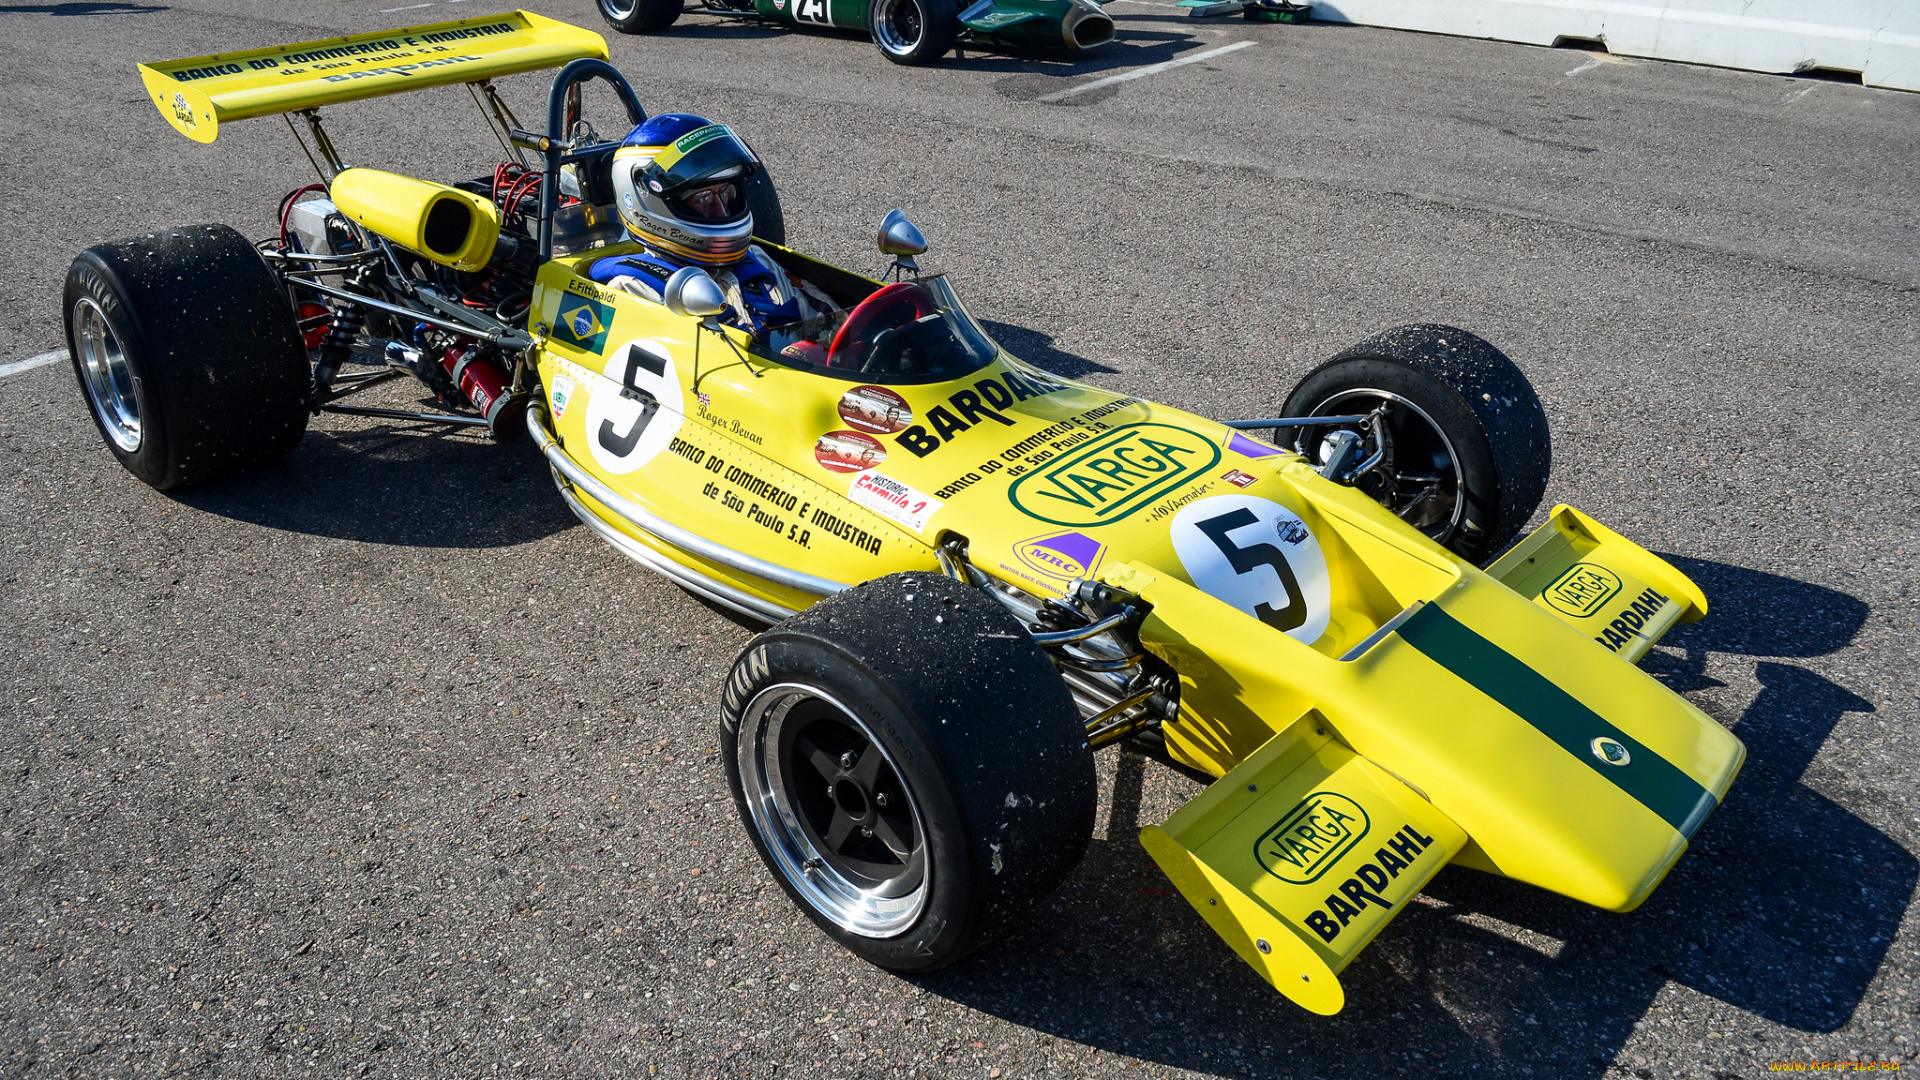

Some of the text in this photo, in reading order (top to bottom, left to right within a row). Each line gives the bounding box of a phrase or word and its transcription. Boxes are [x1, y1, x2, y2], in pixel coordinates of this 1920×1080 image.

[172, 22, 515, 82] BANCO DO COMMERCIO E INDUSTRIA
[280, 68, 309, 76] de
[355, 52, 414, 64] Paulo
[320, 55, 483, 83] BARDAHL
[639, 214, 705, 245] Roger Bevan
[598, 344, 667, 458] 5
[697, 404, 763, 446] Roger Bevan
[934, 472, 982, 500] BANCO
[978, 459, 1004, 474] DO
[999, 421, 1076, 462] COMMERCIO
[1070, 416, 1086, 425] E
[1006, 421, 1115, 477] de São Paulo S.A.
[1036, 437, 1196, 509] VARGA
[668, 437, 882, 556] BANCO DO COMMERCIO E INDUSTRIA
[871, 475, 909, 495] HISTORIC
[702, 482, 811, 550] de São Paulo S.A.
[1000, 563, 1020, 577] MOTOR
[1020, 573, 1035, 583] RACE
[1029, 548, 1078, 573] MRC
[1193, 507, 1308, 632] 5
[1554, 571, 1612, 609] VARGA
[1269, 806, 1356, 868] VARGA
[1303, 824, 1434, 944] BARDAHL
